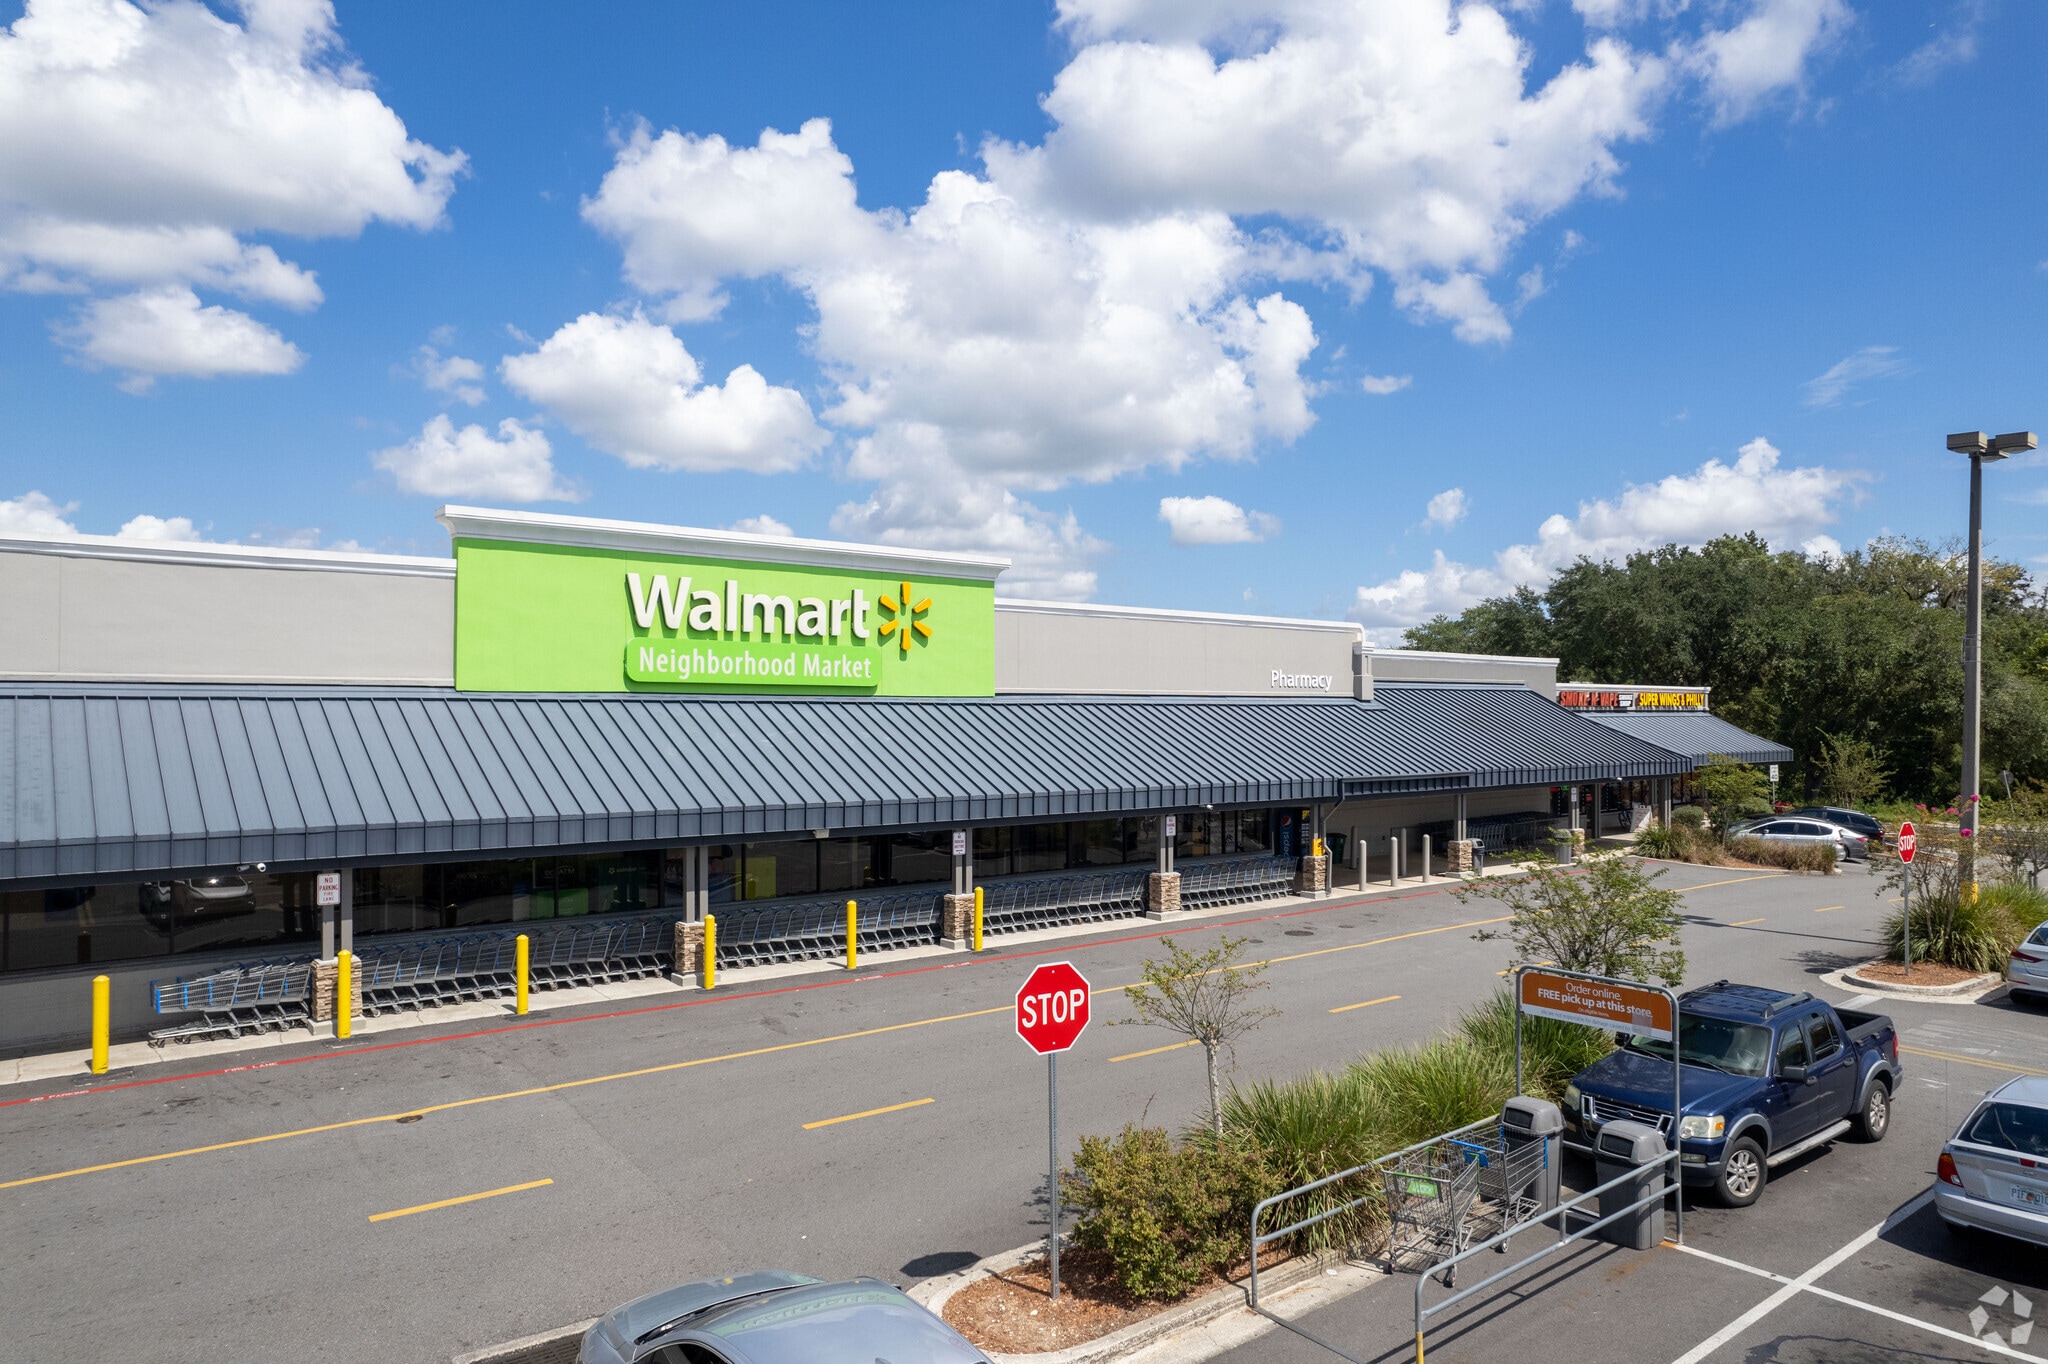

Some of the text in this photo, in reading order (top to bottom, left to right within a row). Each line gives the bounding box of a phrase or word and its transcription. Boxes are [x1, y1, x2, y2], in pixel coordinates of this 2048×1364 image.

[626, 573, 870, 639] Walmart
[639, 647, 872, 680] Neighborhood Market
[1270, 669, 1332, 692] Pharmacy
[1639, 692, 1659, 706] SUPER
[1659, 693, 1680, 707] WINGS
[1686, 693, 1705, 707] PHILLY
[1900, 834, 1915, 851] STOP
[1537, 987, 1560, 1001] FREE
[1561, 992, 1581, 1004] pick
[1582, 997, 1595, 1008] up
[1596, 1000, 1606, 1009] at
[1607, 1000, 1625, 1013] this
[1565, 982, 1622, 1001] Order online.
[1022, 988, 1085, 1029] STOP
[49, 1090, 89, 1099] PARKING
